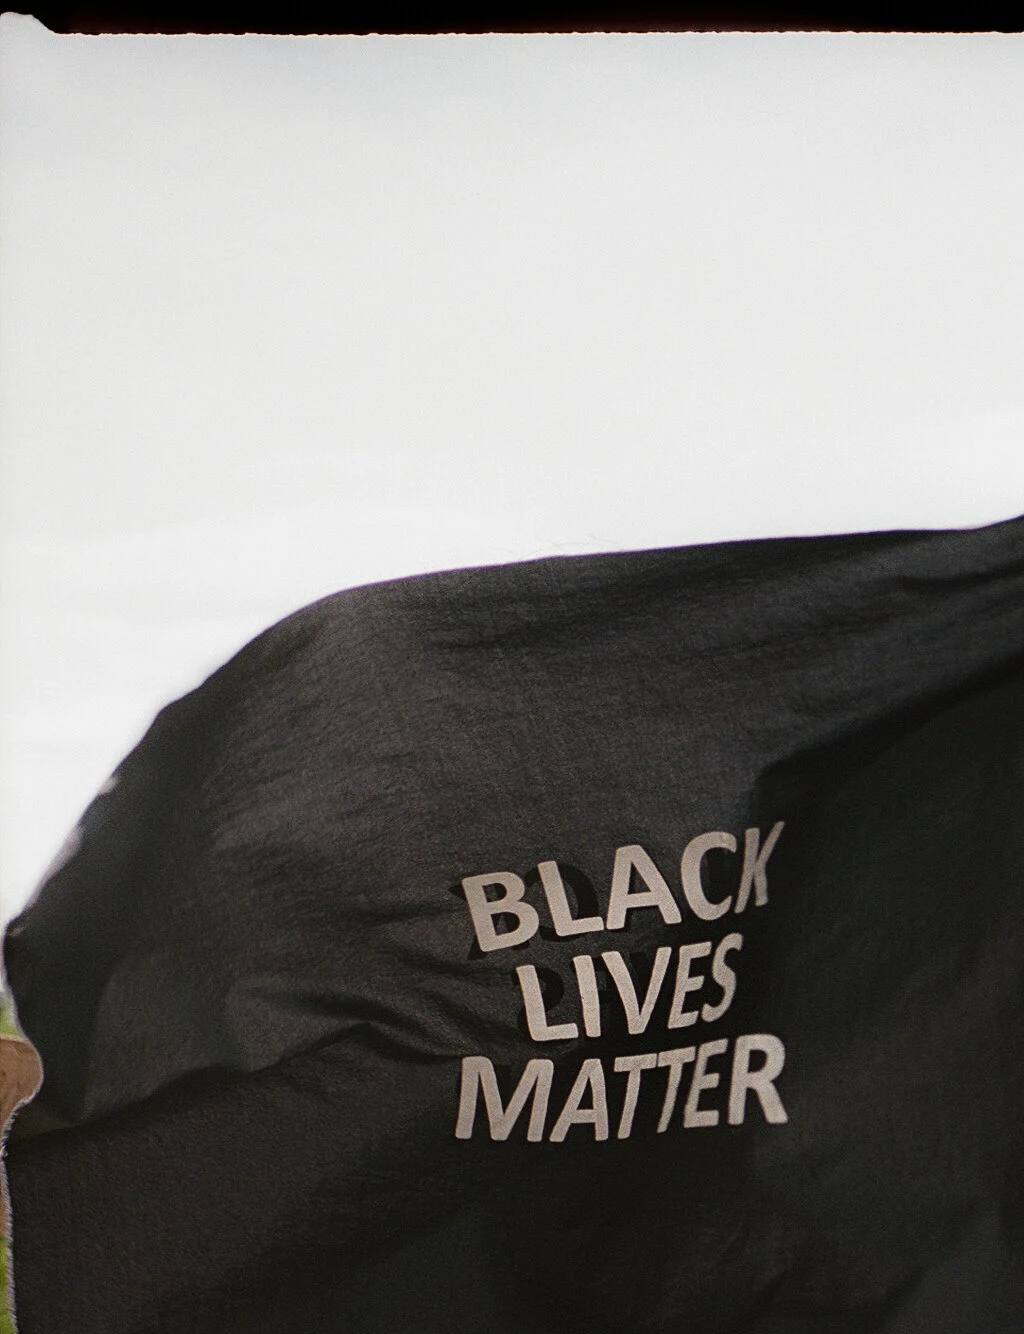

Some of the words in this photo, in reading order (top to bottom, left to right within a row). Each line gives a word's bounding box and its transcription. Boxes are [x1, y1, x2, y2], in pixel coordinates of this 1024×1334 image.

[461, 821, 786, 953] BLACK
[516, 933, 743, 1042] LIVES
[455, 1034, 788, 1142] MATTER
